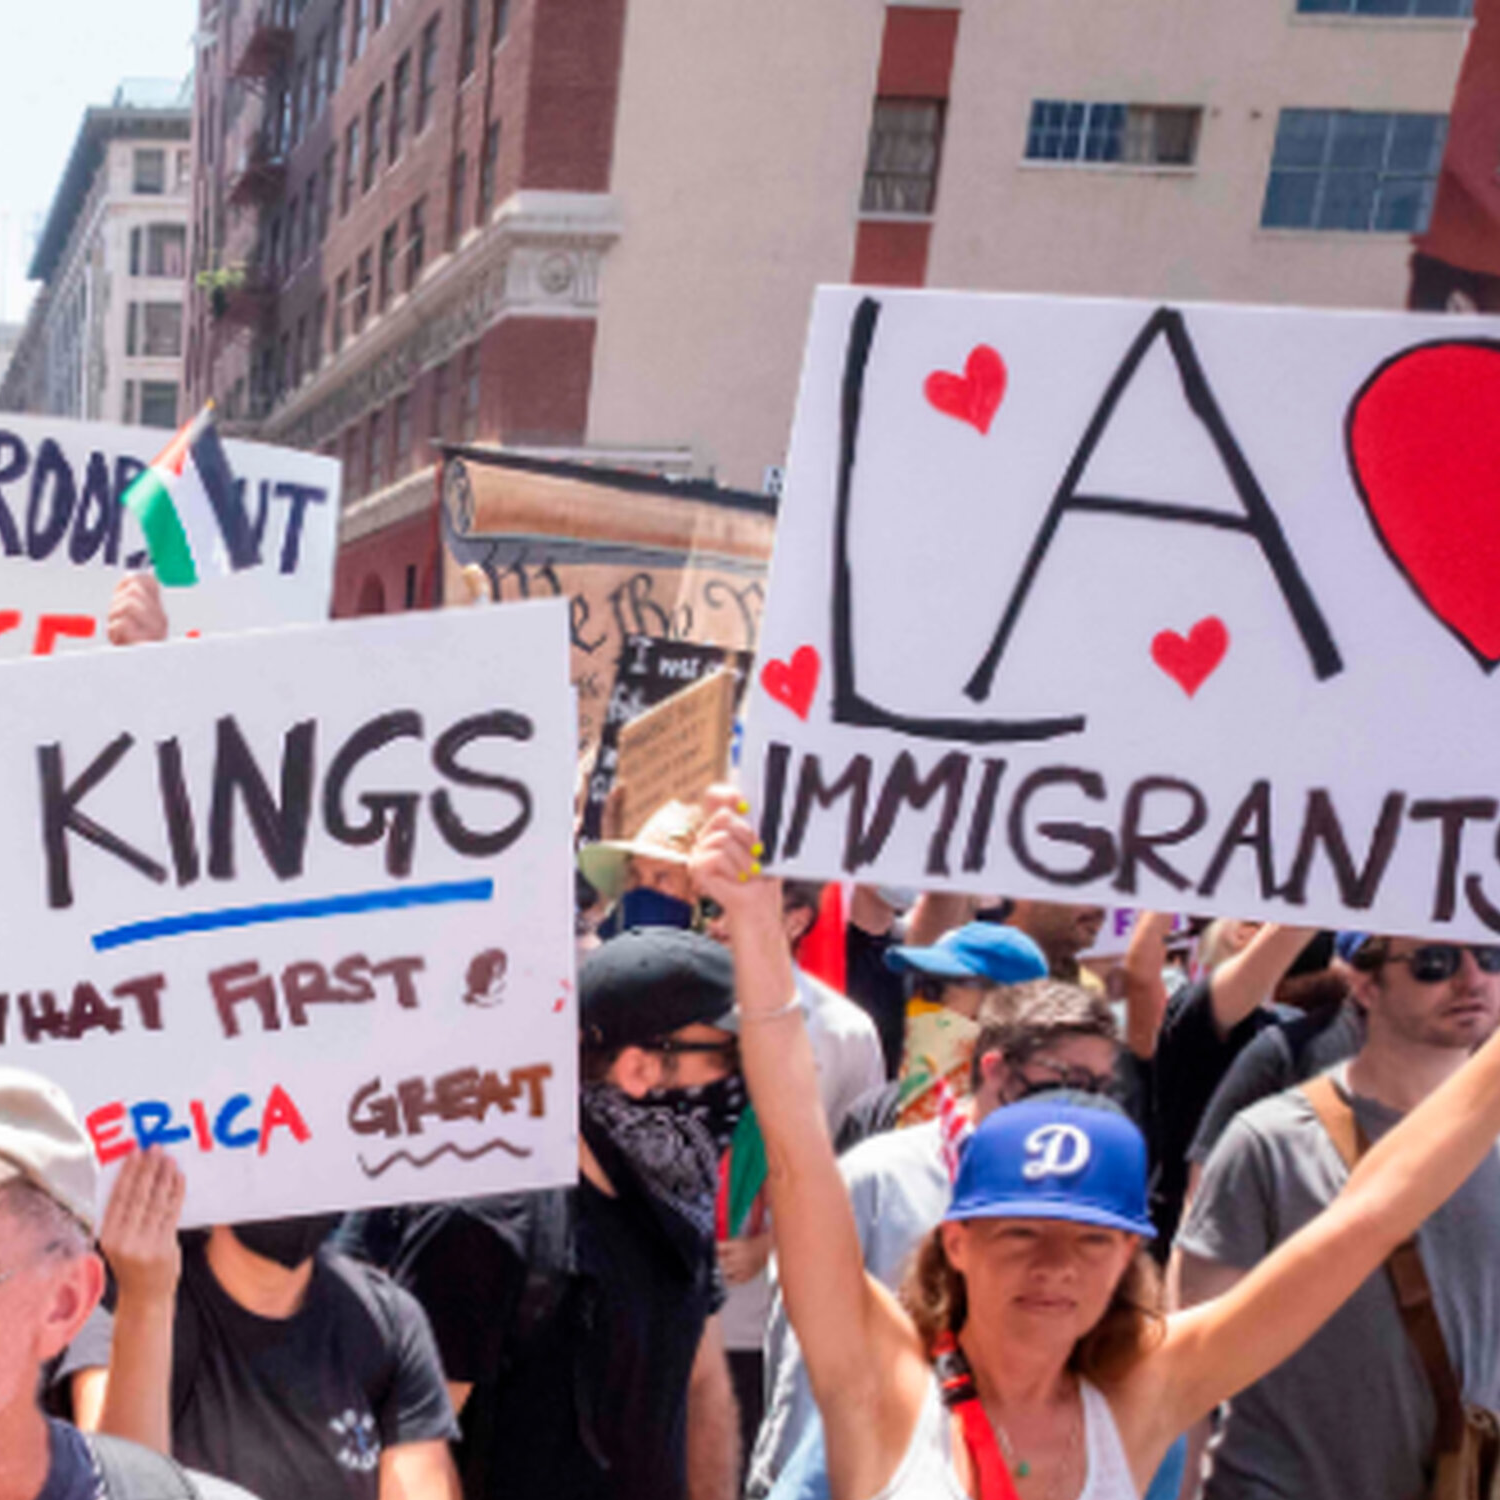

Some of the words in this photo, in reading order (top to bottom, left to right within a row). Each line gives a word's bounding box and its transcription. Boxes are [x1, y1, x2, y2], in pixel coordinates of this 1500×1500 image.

[232, 477, 328, 574] UT
[832, 297, 1343, 745] LA
[38, 710, 534, 910] KINGS
[207, 954, 426, 1039] FIRST
[86, 1083, 312, 1165] ERICA
[348, 1063, 554, 1139] GREAT
[1022, 1123, 1091, 1180] D
